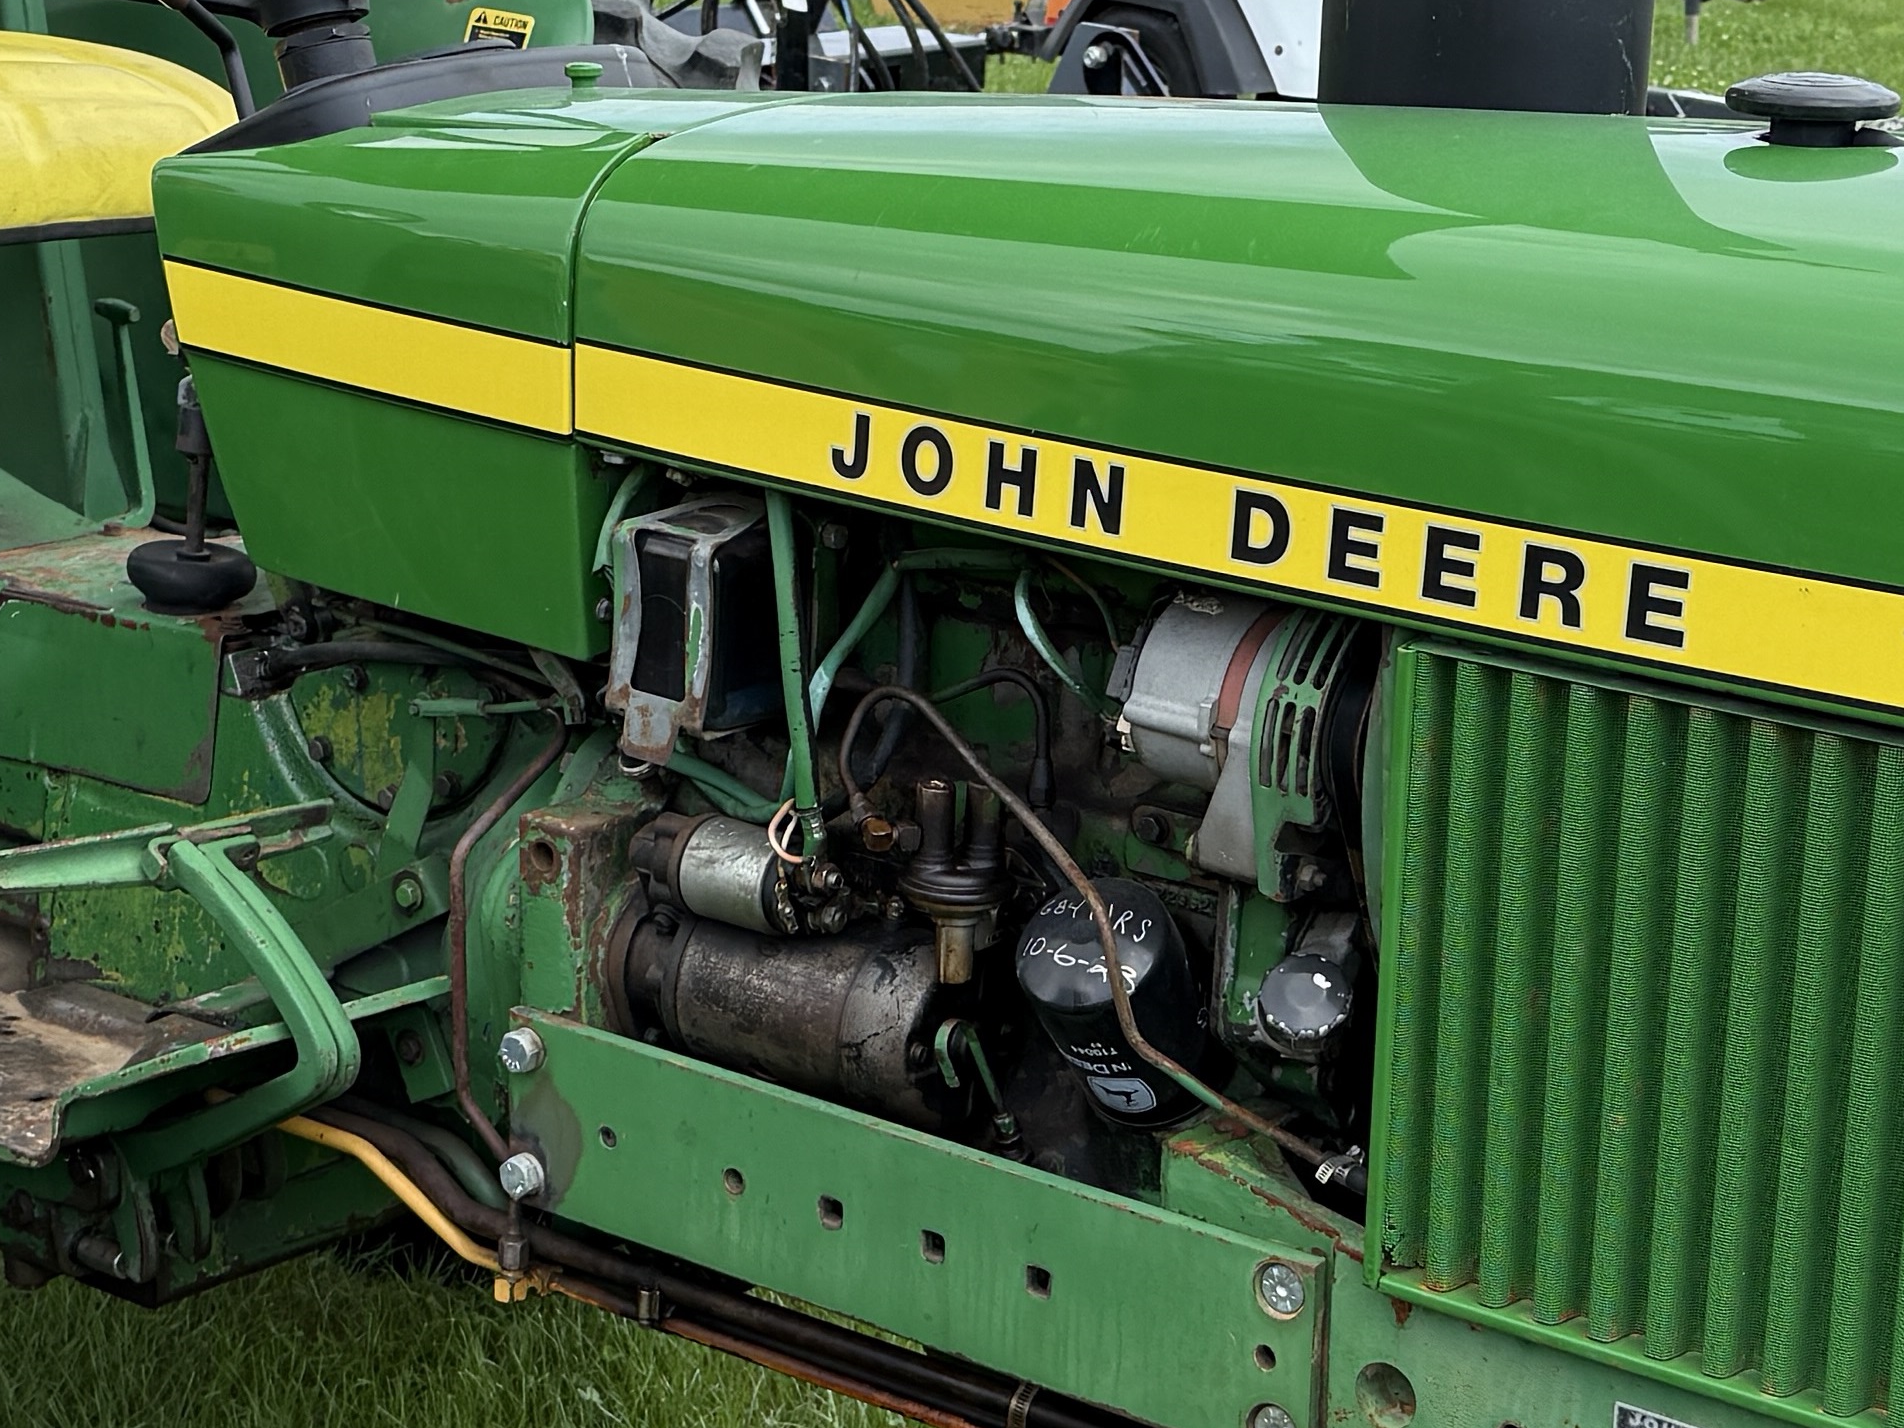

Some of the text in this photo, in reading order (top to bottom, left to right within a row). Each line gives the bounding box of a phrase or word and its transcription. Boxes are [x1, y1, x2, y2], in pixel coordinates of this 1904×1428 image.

[493, 15, 529, 30] CAUTION
[829, 410, 1692, 650] JOHN DEERE
